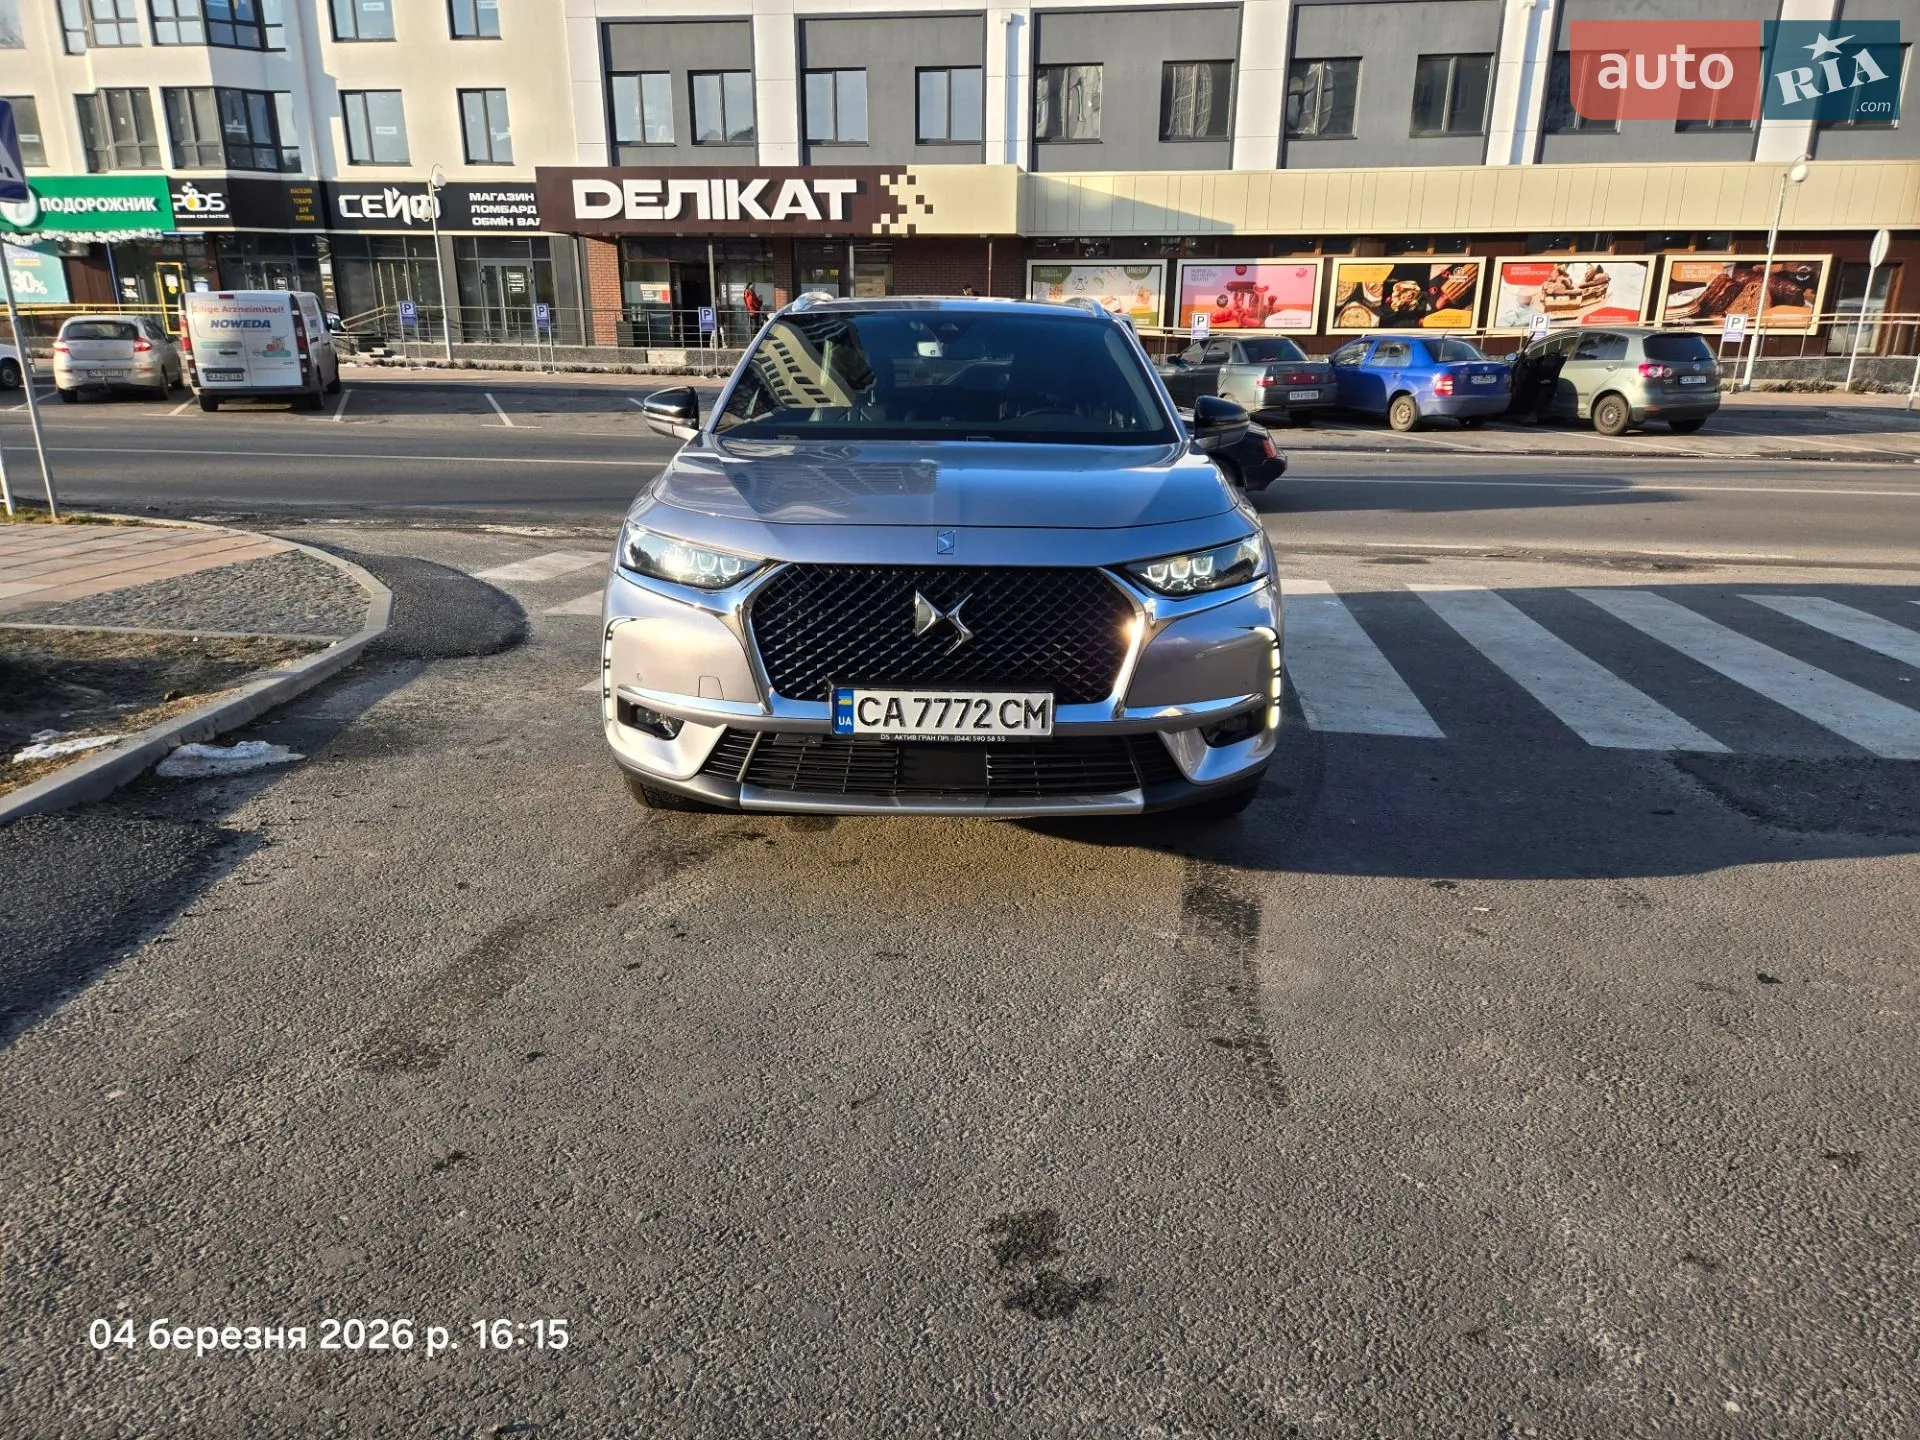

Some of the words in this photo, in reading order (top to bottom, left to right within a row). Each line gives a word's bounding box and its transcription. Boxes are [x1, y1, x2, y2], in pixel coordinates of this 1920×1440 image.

[469, 192, 535, 202] МАГАЗИН
[39, 197, 158, 214] ПОДОРОЖНИК
[338, 187, 441, 226] СЕЙФ
[471, 205, 538, 215] ЛОМБАРД
[472, 215, 514, 226] ОБМІН
[210, 319, 272, 329] NOWEDA
[838, 717, 852, 727] UA
